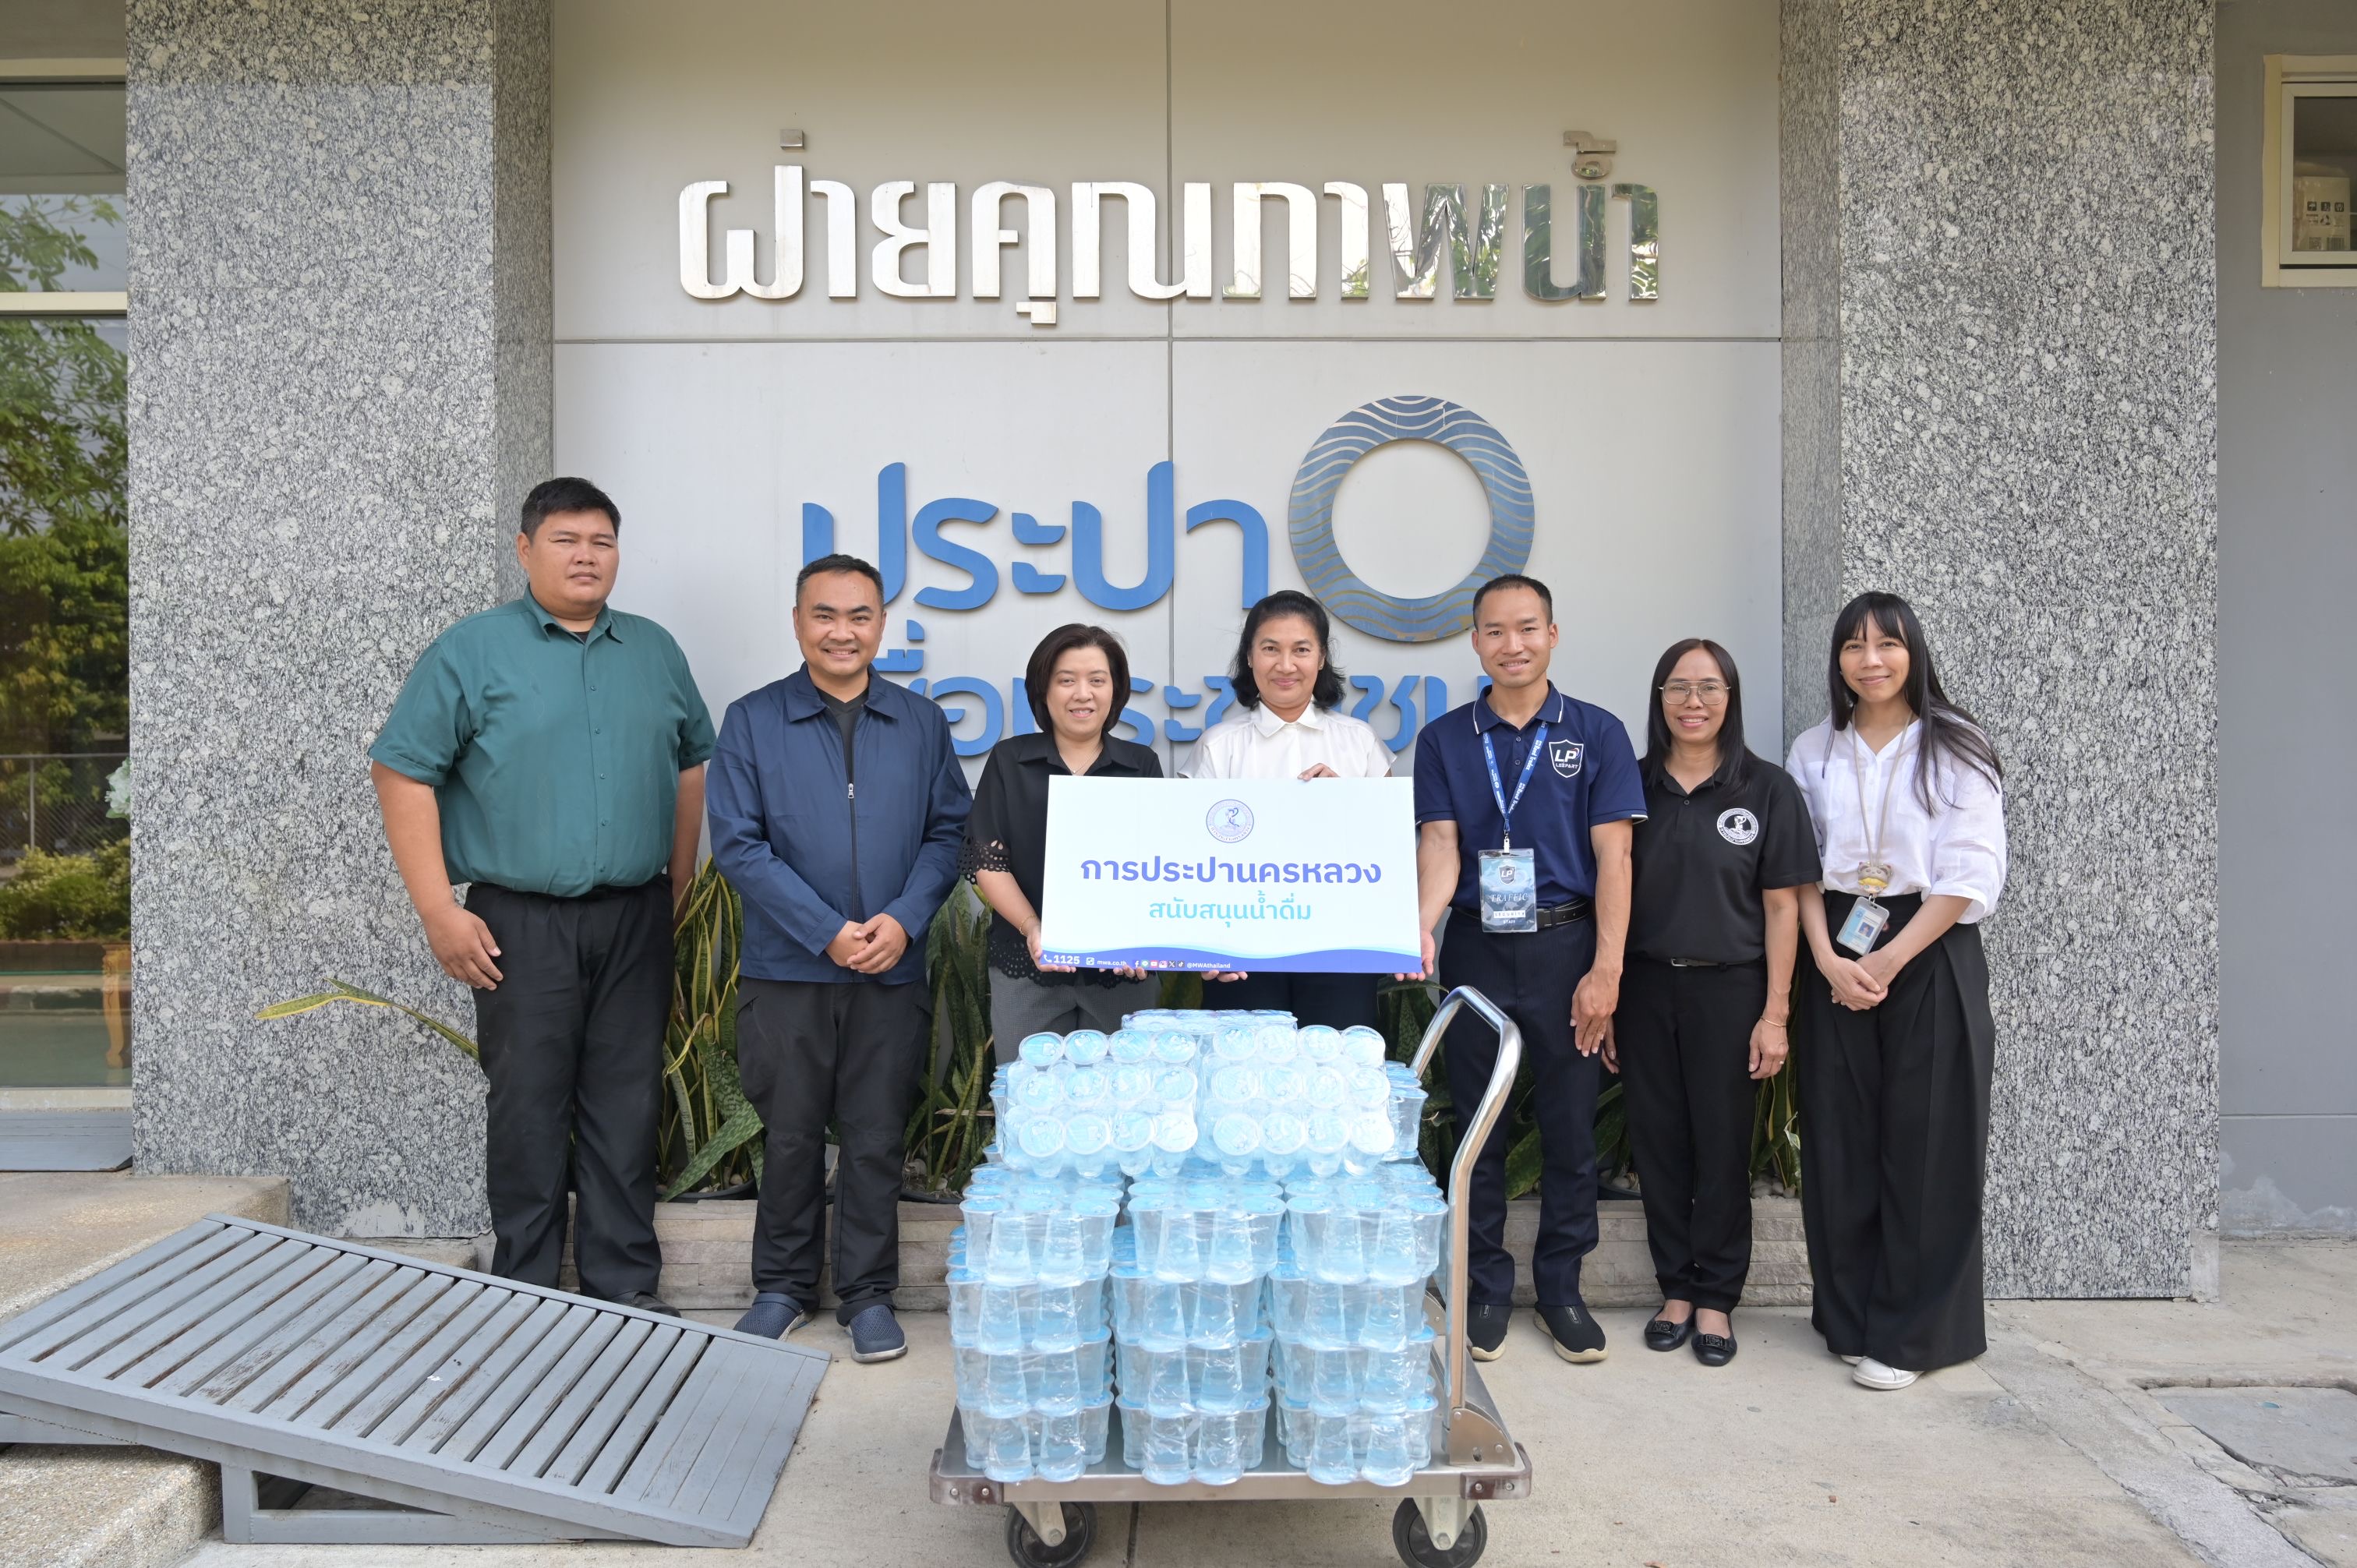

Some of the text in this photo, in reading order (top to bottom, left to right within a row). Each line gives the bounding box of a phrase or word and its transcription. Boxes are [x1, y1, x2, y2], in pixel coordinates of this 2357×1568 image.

[679, 129, 1658, 325] ฝ่ายคุณภาพน้ำ
[803, 461, 1268, 610] ประปา
[1555, 749, 1578, 762] LP
[1080, 856, 1382, 884] การประปานครหลวง
[1149, 890, 1312, 928] สนับสนุนน้ำดื่ม
[1054, 955, 1080, 965] 1125
